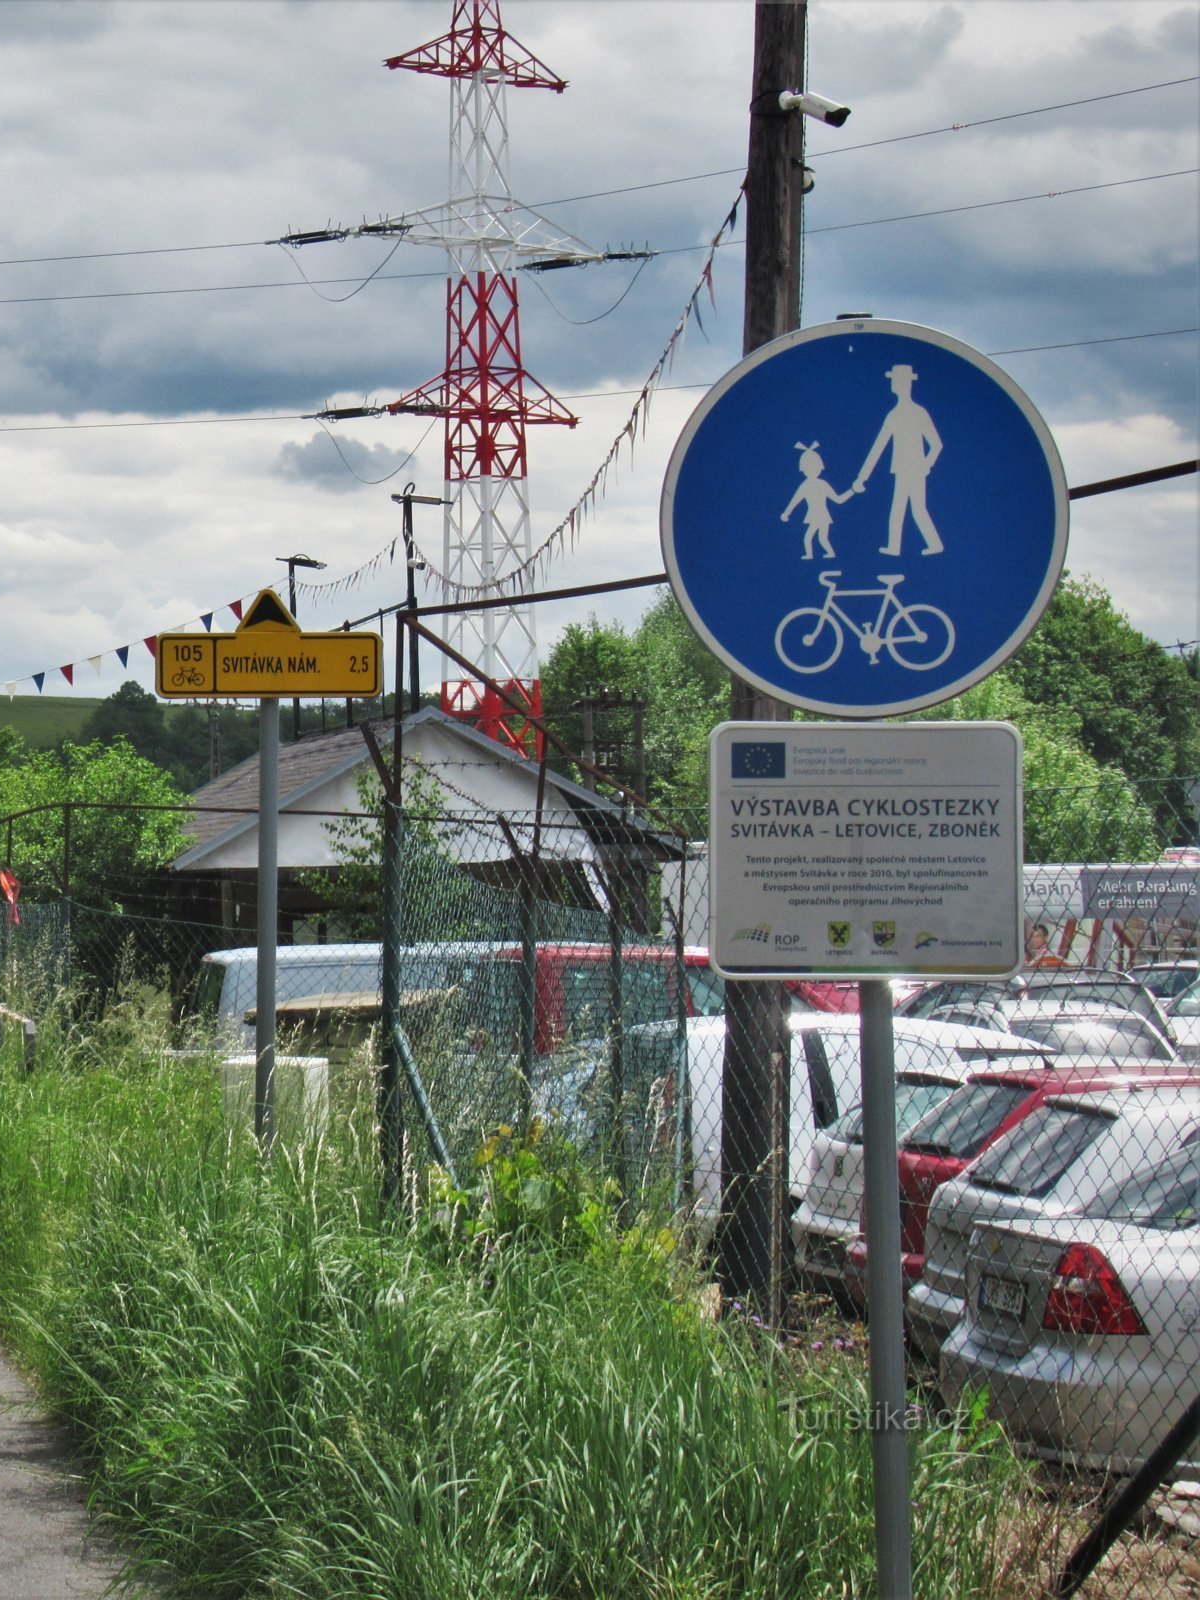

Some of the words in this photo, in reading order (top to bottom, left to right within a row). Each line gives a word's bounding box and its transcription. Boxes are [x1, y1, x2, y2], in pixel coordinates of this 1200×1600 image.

[173, 645, 203, 662] 105
[222, 653, 283, 674] SVITÁVKA
[287, 653, 321, 674] NÁM.
[349, 656, 369, 673] 2,5
[731, 796, 840, 816] VÝSTAVBA
[847, 799, 1000, 816] CYKLOSTEZKY
[731, 821, 814, 838] SVITÁVKA
[836, 823, 923, 840] LETOVICE,
[928, 821, 1001, 838] ZBONĚK
[746, 855, 771, 864] Tento
[773, 855, 809, 867] projekt,
[811, 855, 864, 867] realizovaný
[865, 855, 907, 867] společně
[908, 855, 945, 864] městem
[947, 855, 987, 864] Letovice
[743, 871, 750, 879] a
[751, 869, 798, 880] městysem
[799, 868, 838, 878] Svitávka
[840, 870, 846, 878] v
[847, 870, 868, 878] roce
[896, 868, 911, 880] byl
[912, 868, 989, 880] spolufinancován
[762, 882, 810, 894] Evropskou
[832, 882, 906, 894] prostřednictvím
[907, 882, 969, 894] Regionálního
[1098, 880, 1132, 893] Mehr
[1136, 880, 1197, 896] Beratung
[788, 897, 841, 907] operačního
[842, 898, 889, 907] programu
[890, 896, 943, 907] Jihovýchod
[775, 934, 800, 946] ROP
